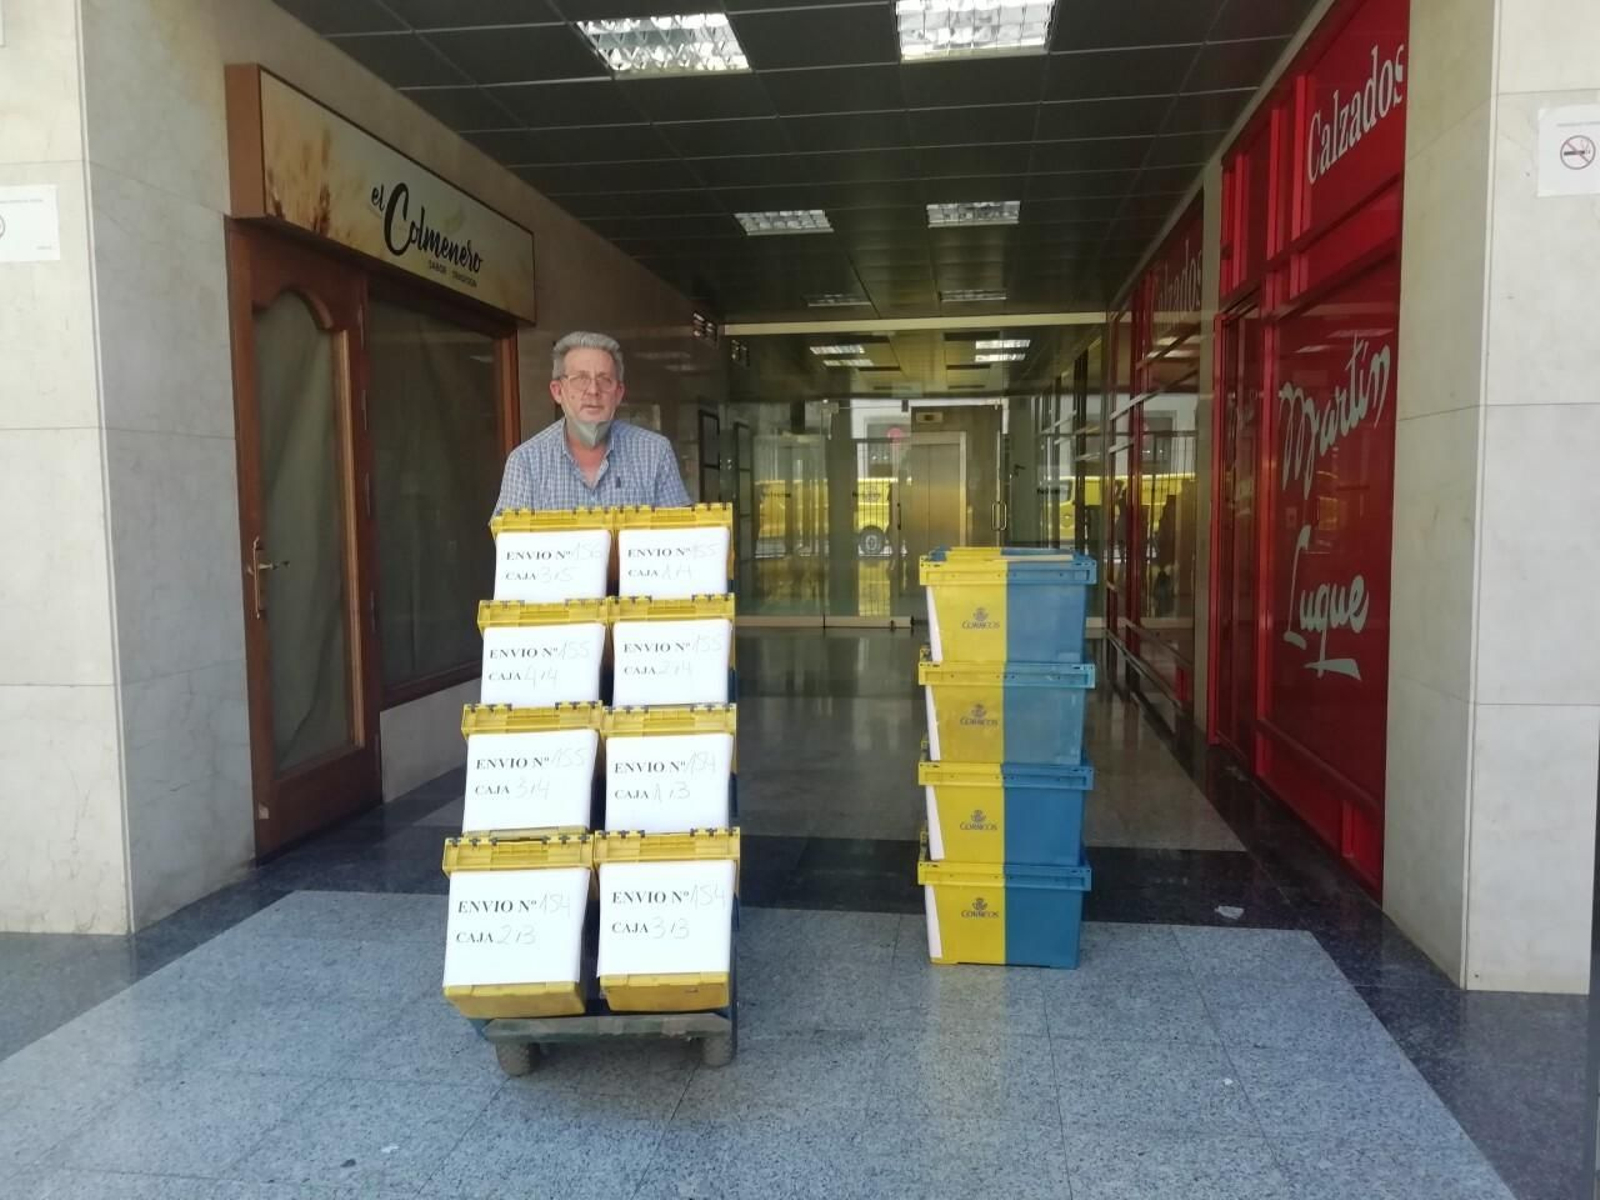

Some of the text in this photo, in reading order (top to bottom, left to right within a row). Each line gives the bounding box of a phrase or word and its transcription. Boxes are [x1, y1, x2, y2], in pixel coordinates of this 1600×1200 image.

[1307, 43, 1405, 186] Calzados
[371, 182, 484, 274] el Colmenero
[506, 550, 552, 560] ENVIO
[628, 548, 672, 558] ENVIO
[505, 571, 537, 580] CAJA
[627, 569, 659, 578] CAJA
[1284, 524, 1370, 681] Luque
[489, 648, 538, 659] ENVIO
[623, 643, 671, 654] ENVIO
[488, 672, 522, 681] CAJA
[623, 666, 656, 676] CAJA
[476, 757, 528, 770] ENVIO
[614, 761, 665, 774] ENVIO
[474, 784, 510, 796] CAJA
[614, 789, 650, 800] CAJA
[610, 890, 667, 905] ENVIO
[690, 883, 727, 910] 154
[458, 900, 514, 914] ENVIO
[539, 893, 572, 918] 154
[610, 921, 649, 934] CAJA
[456, 932, 494, 944] CAJA
